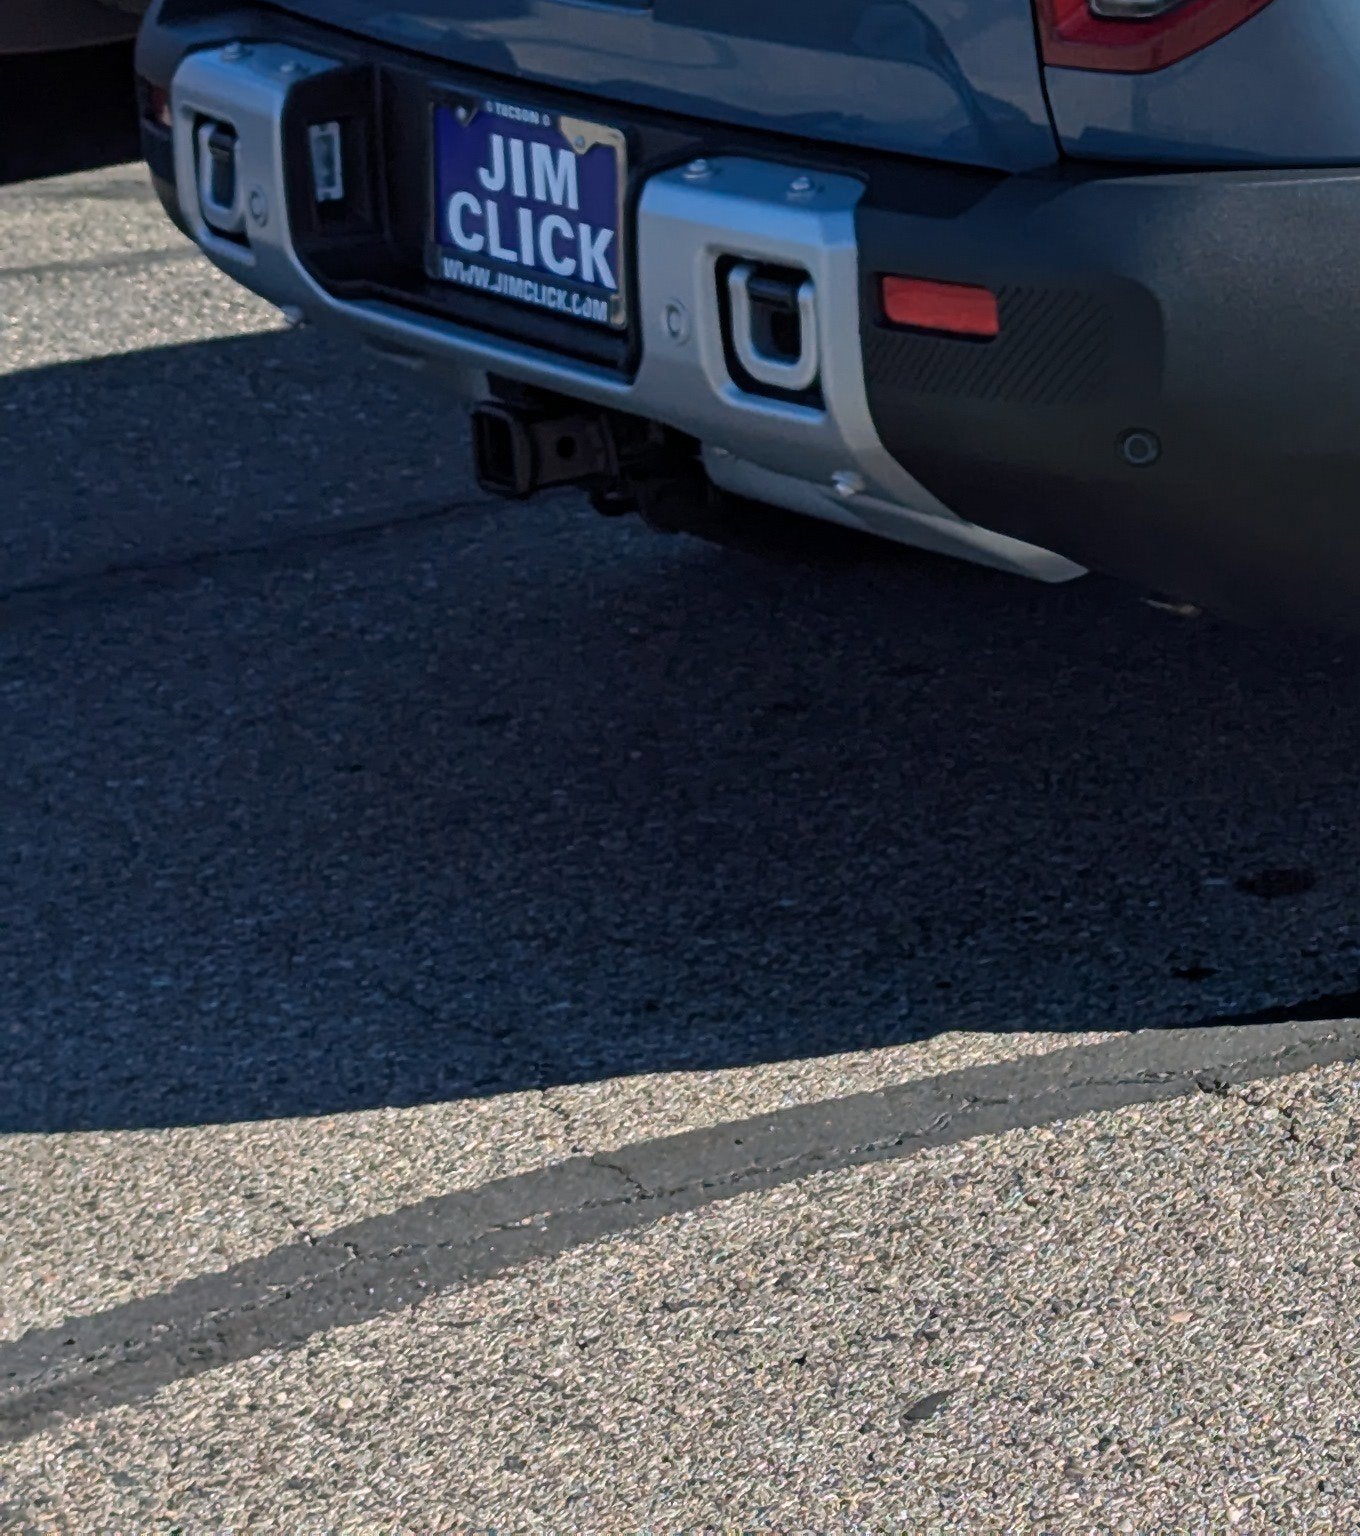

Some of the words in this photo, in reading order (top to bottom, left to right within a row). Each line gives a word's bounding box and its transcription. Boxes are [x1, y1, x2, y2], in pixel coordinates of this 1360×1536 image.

[478, 134, 579, 210] JIM
[449, 191, 617, 290] CLICK
[443, 257, 608, 322] WWW.JIMCLICK.COM
